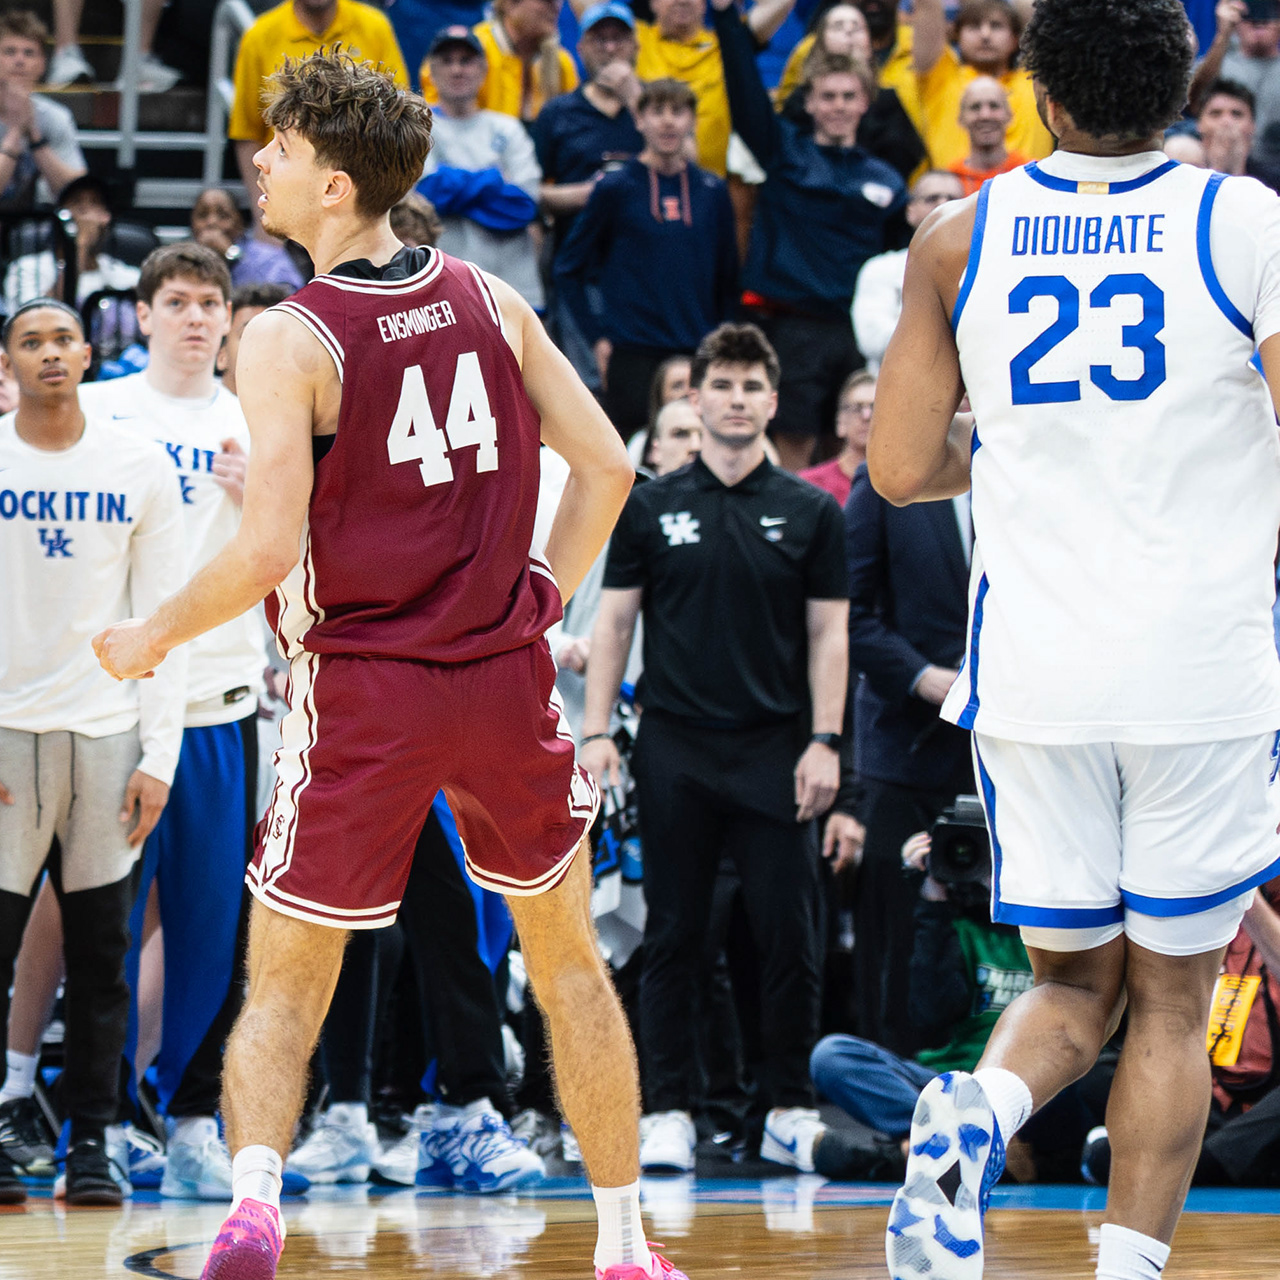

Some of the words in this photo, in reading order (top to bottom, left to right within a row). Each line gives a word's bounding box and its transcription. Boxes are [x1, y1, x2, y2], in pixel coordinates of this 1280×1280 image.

[1011, 213, 1166, 256] DIOUBATE
[376, 299, 457, 344] ENSMINGER
[1007, 272, 1167, 406] 23
[386, 350, 499, 488] 44
[65, 491, 90, 521] IT
[96, 492, 133, 524] IN.
[38, 527, 74, 558] UK
